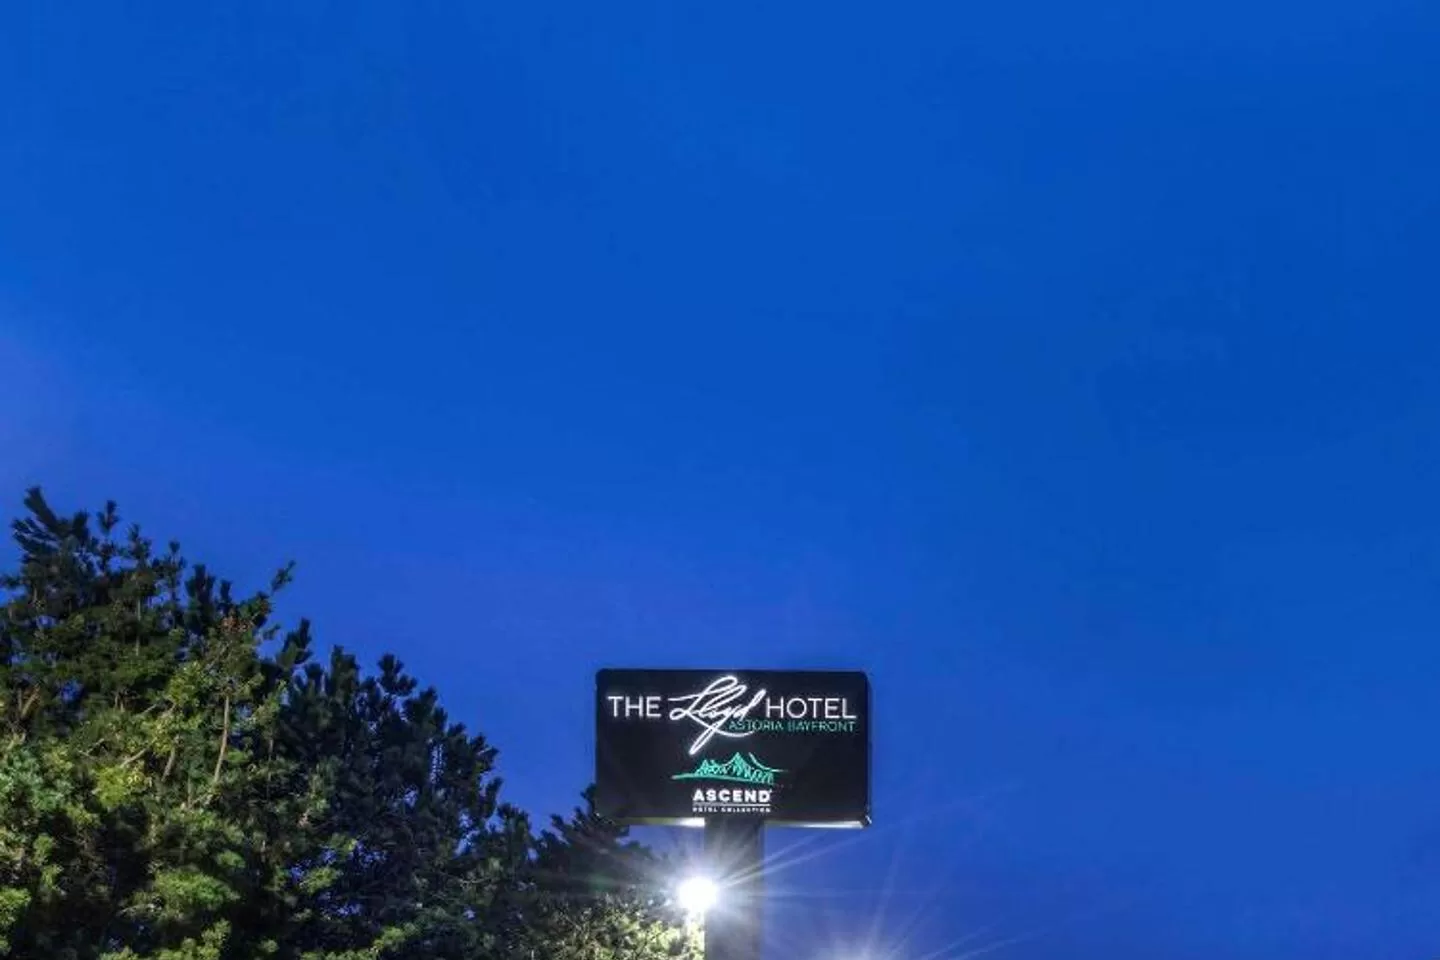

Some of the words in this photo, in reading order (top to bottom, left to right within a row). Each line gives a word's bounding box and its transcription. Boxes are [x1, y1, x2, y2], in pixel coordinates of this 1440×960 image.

[607, 695, 662, 718] THE
[667, 675, 767, 756] Lloyd
[765, 697, 857, 719] HOTEL
[728, 720, 784, 732] ASTORIA
[787, 721, 856, 733] BAYFRONT
[692, 788, 771, 803] ASCEND
